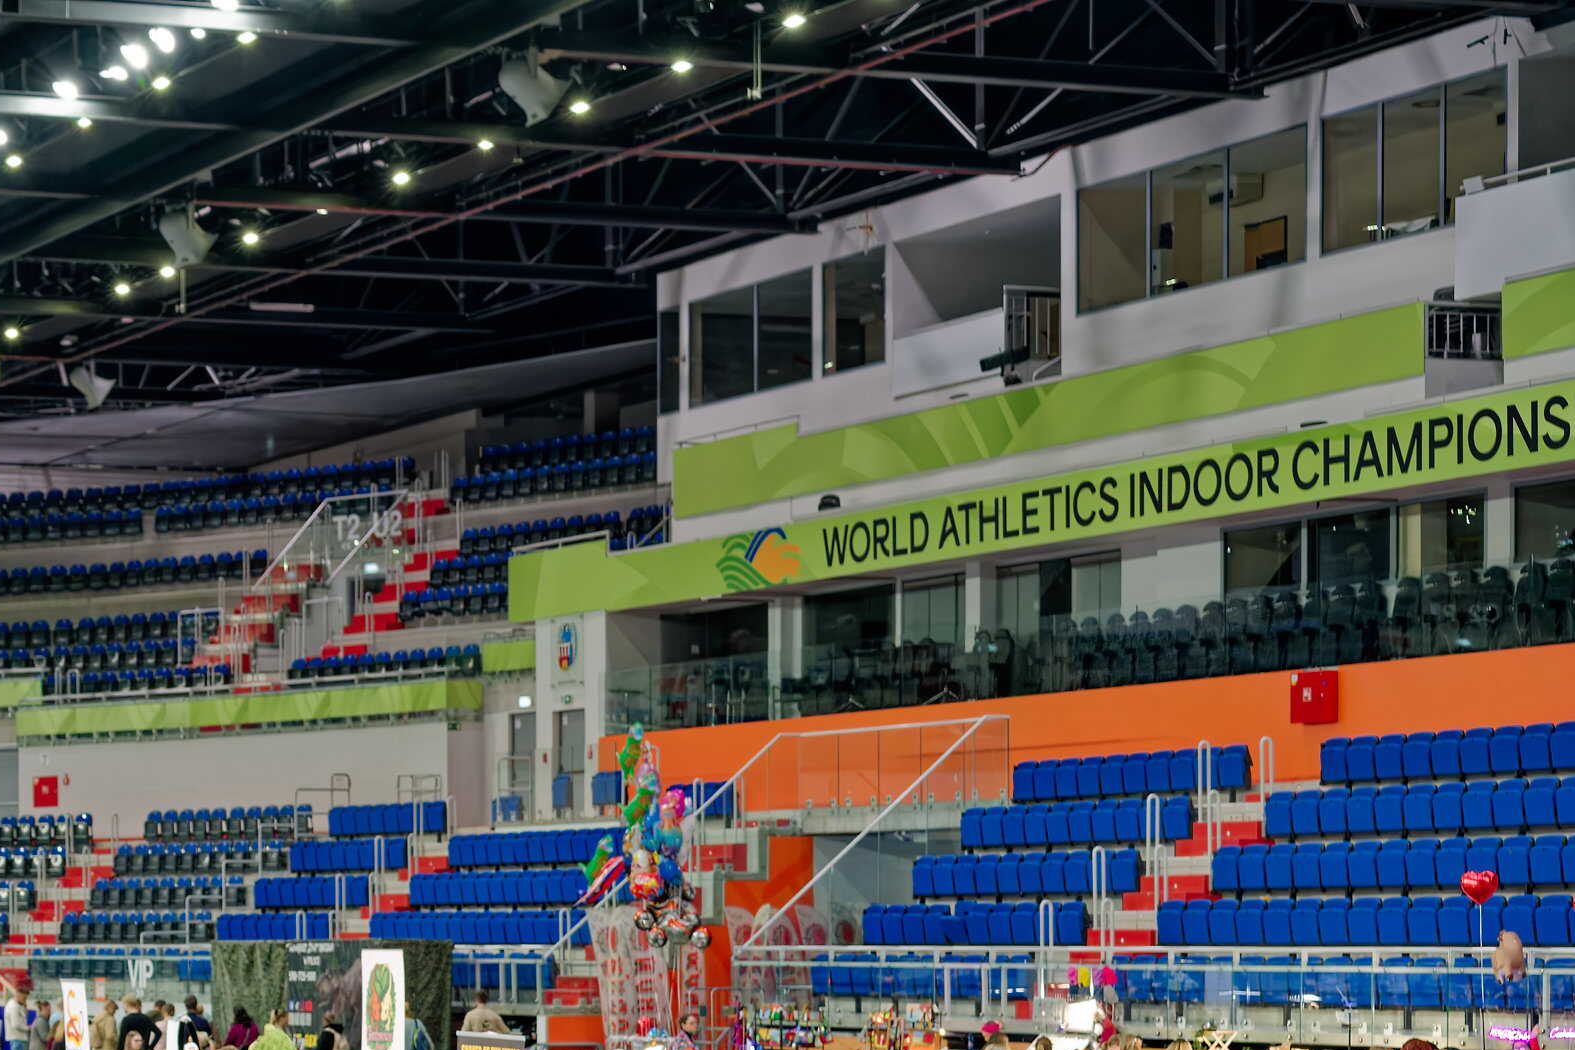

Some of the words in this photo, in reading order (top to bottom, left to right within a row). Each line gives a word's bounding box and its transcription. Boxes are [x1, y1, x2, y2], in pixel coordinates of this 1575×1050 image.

[822, 510, 930, 568] WORLD
[937, 476, 1120, 550] ATHLETICS
[1129, 447, 1280, 519] INDOOR
[1291, 395, 1571, 491] CHAMPIONS
[332, 514, 360, 542] T2
[373, 509, 402, 537] U2
[127, 959, 154, 989] VIP
